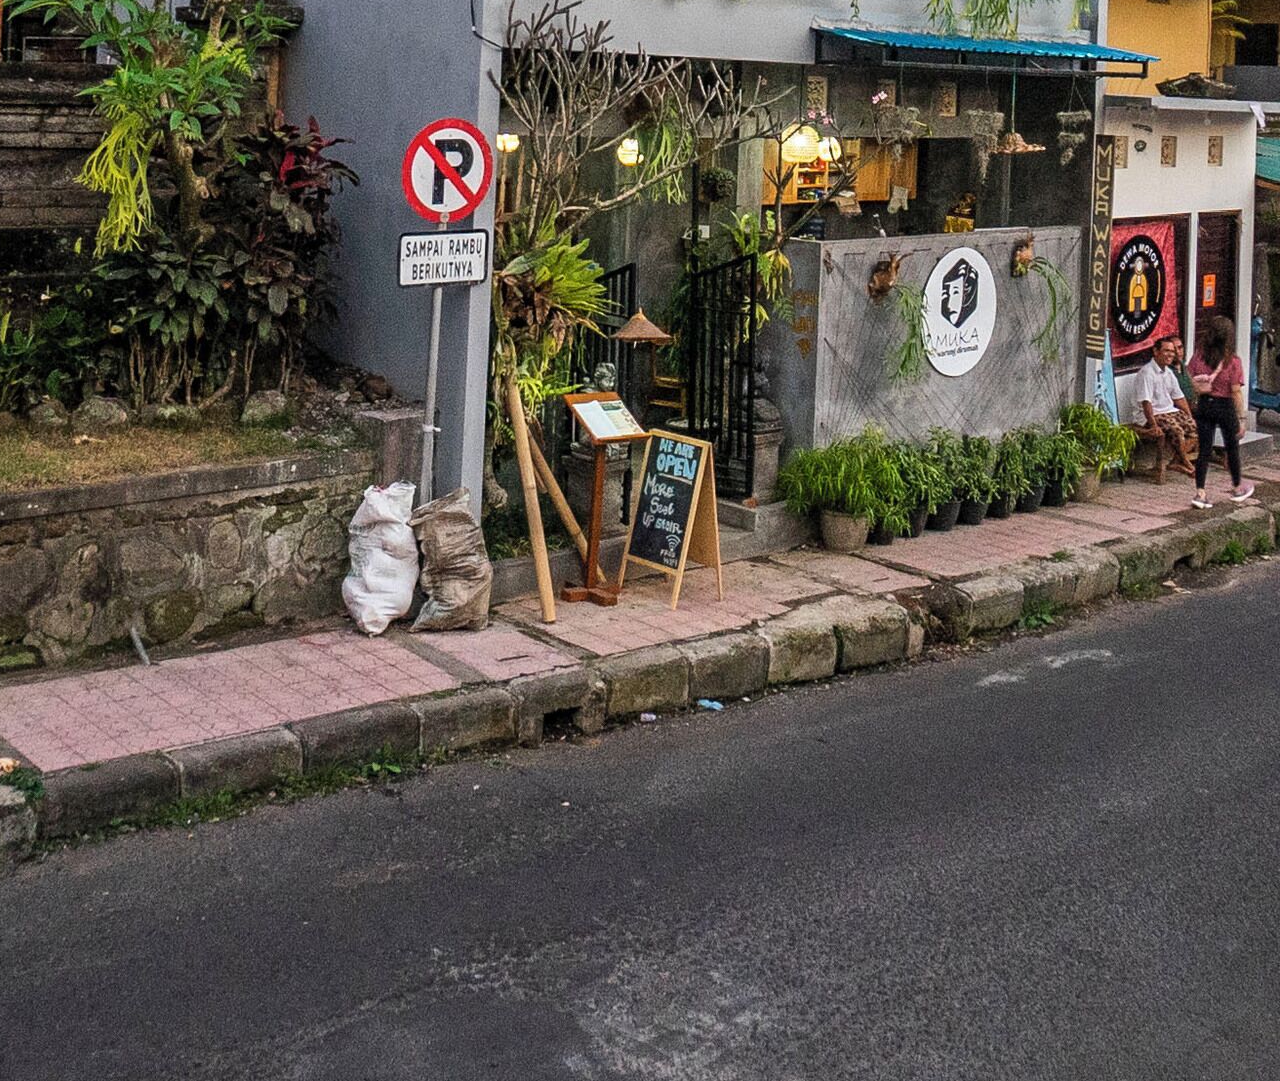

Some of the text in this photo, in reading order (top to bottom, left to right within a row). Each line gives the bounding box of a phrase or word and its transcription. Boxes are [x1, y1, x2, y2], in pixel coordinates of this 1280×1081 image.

[431, 138, 475, 205] P
[405, 237, 483, 259] SAMPAI RAMBU
[1088, 144, 1113, 331] MUKA WARUNG
[1120, 243, 1160, 271] DEWA MOTOR
[412, 260, 473, 281] BERIKUTNYA
[1118, 310, 1157, 335] BALI RENTAL
[935, 327, 980, 348] MUKA
[673, 441, 696, 459] ARE
[656, 453, 697, 480] OPEN
